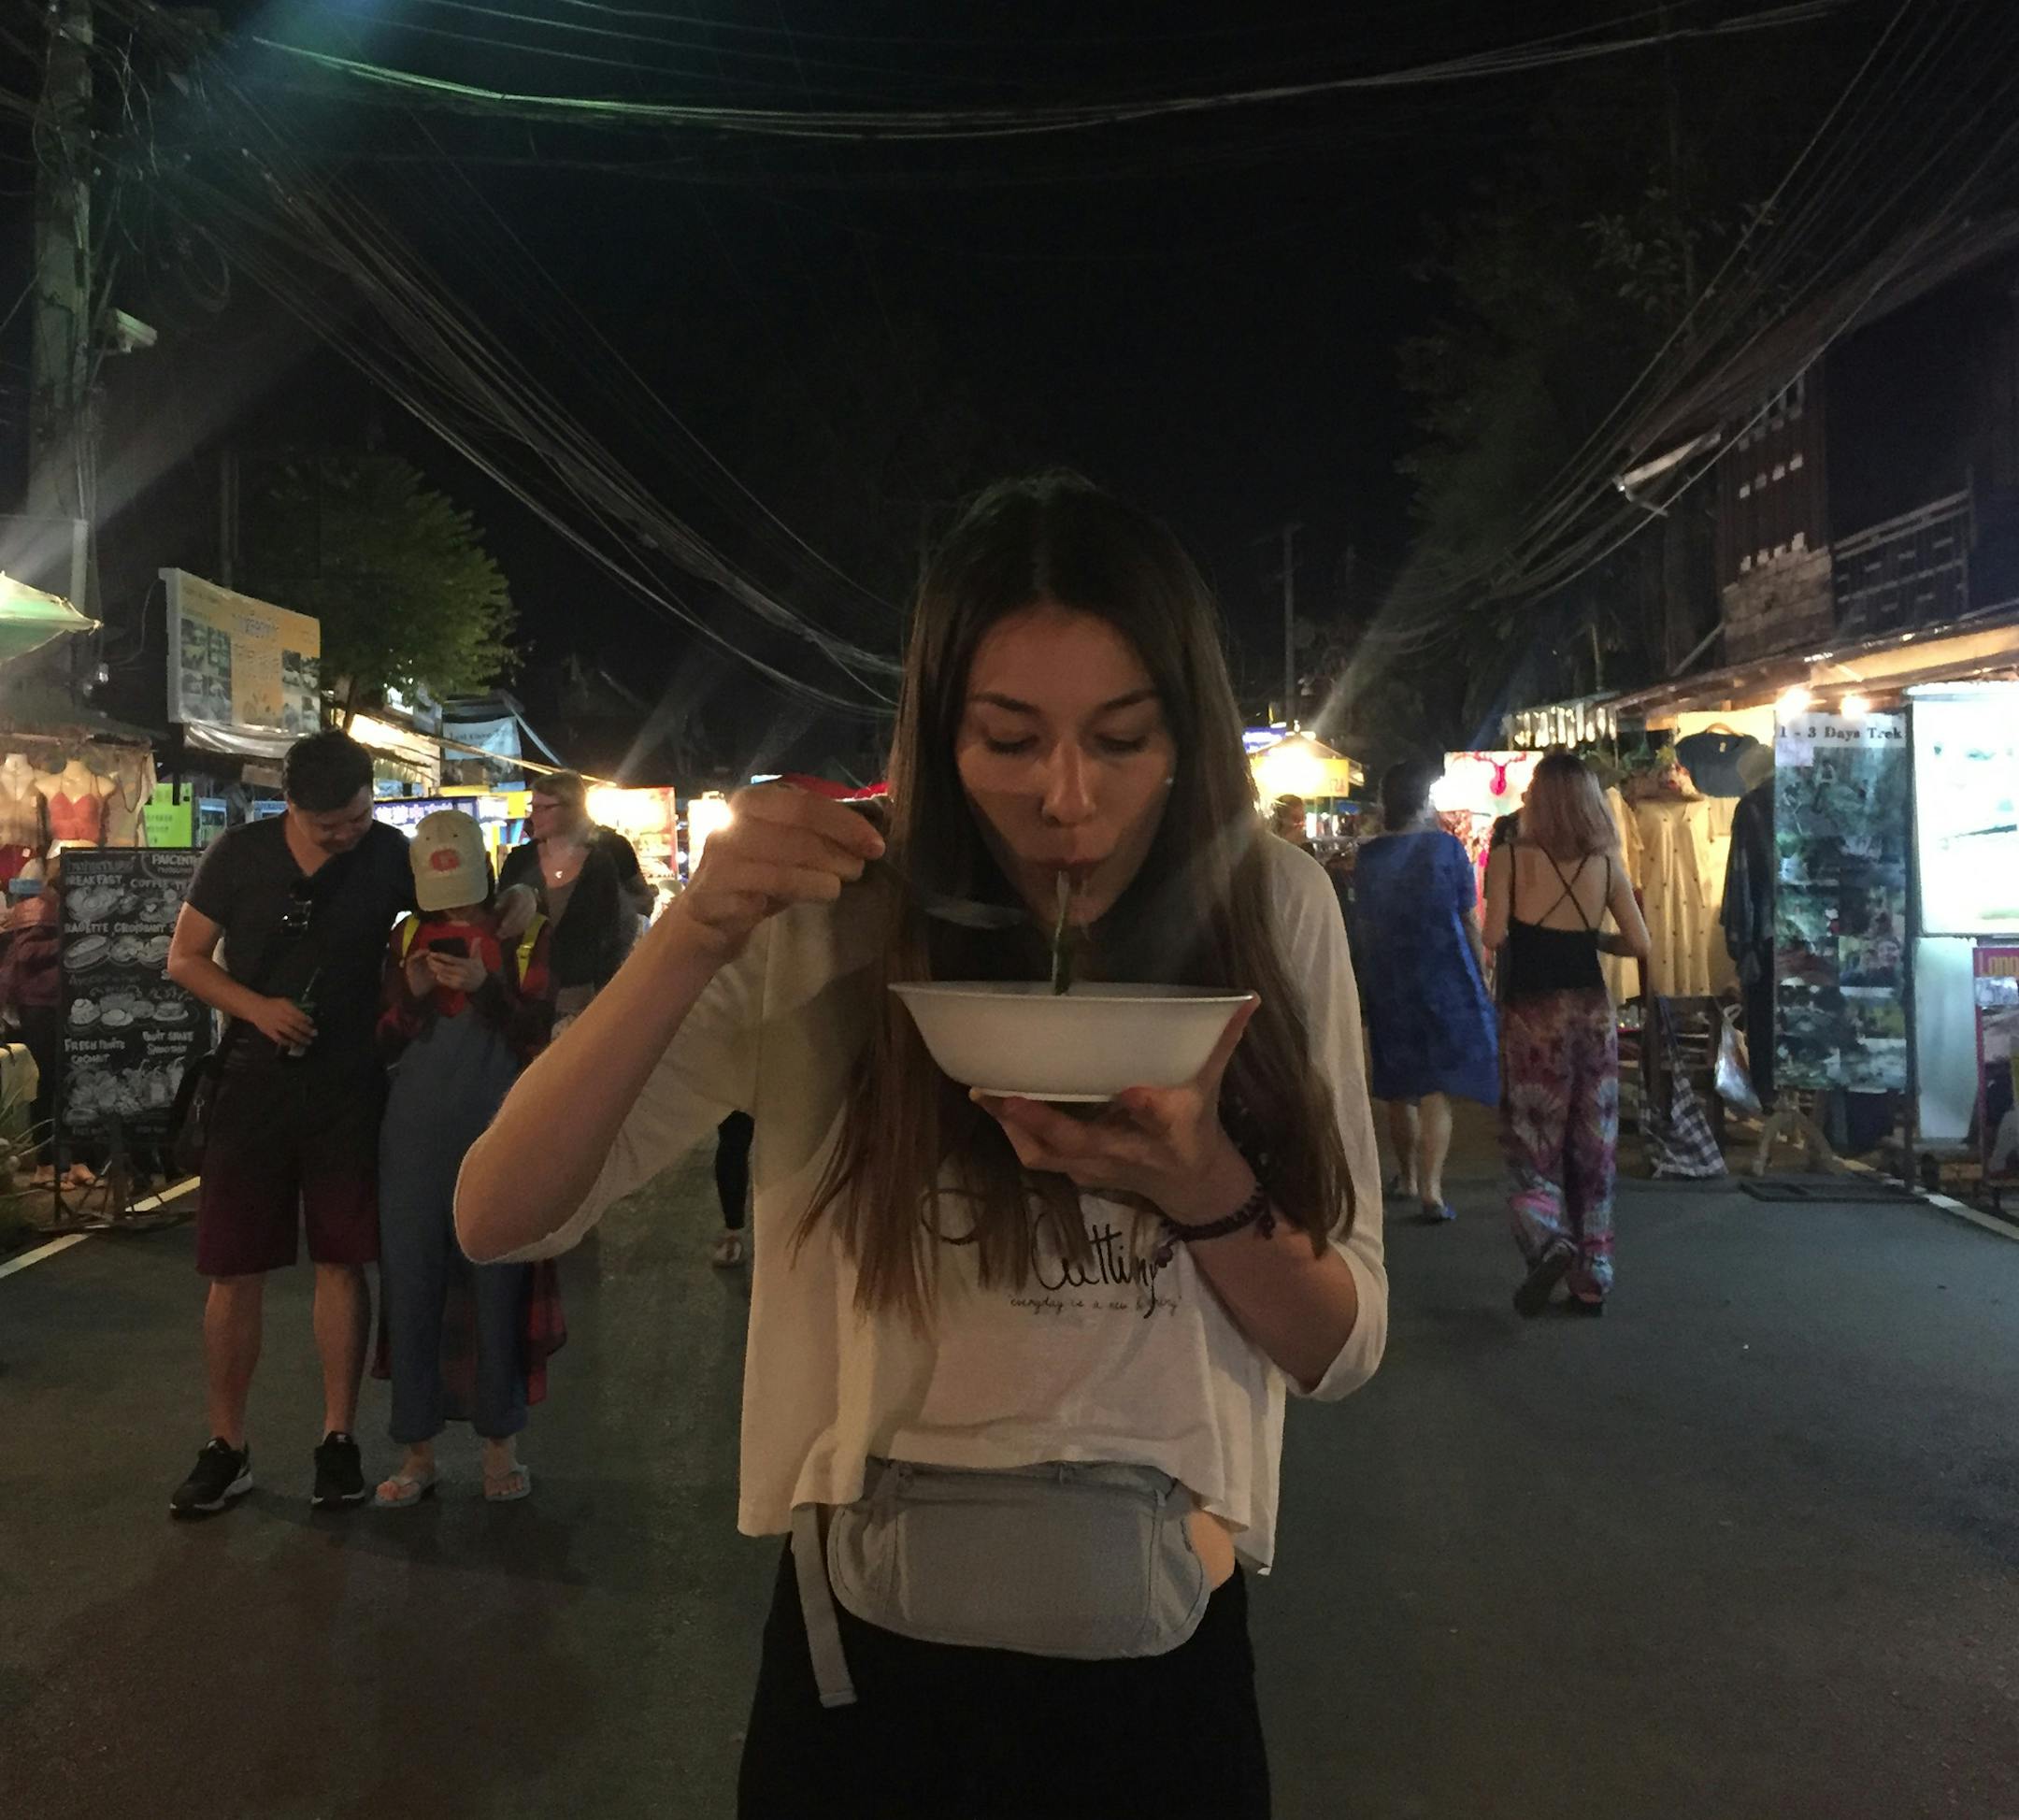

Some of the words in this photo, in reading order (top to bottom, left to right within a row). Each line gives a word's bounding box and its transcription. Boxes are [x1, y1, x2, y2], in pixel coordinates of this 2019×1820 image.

[1780, 725, 1786, 738] 1
[1807, 725, 1817, 738] 3
[1824, 725, 1861, 741] Days
